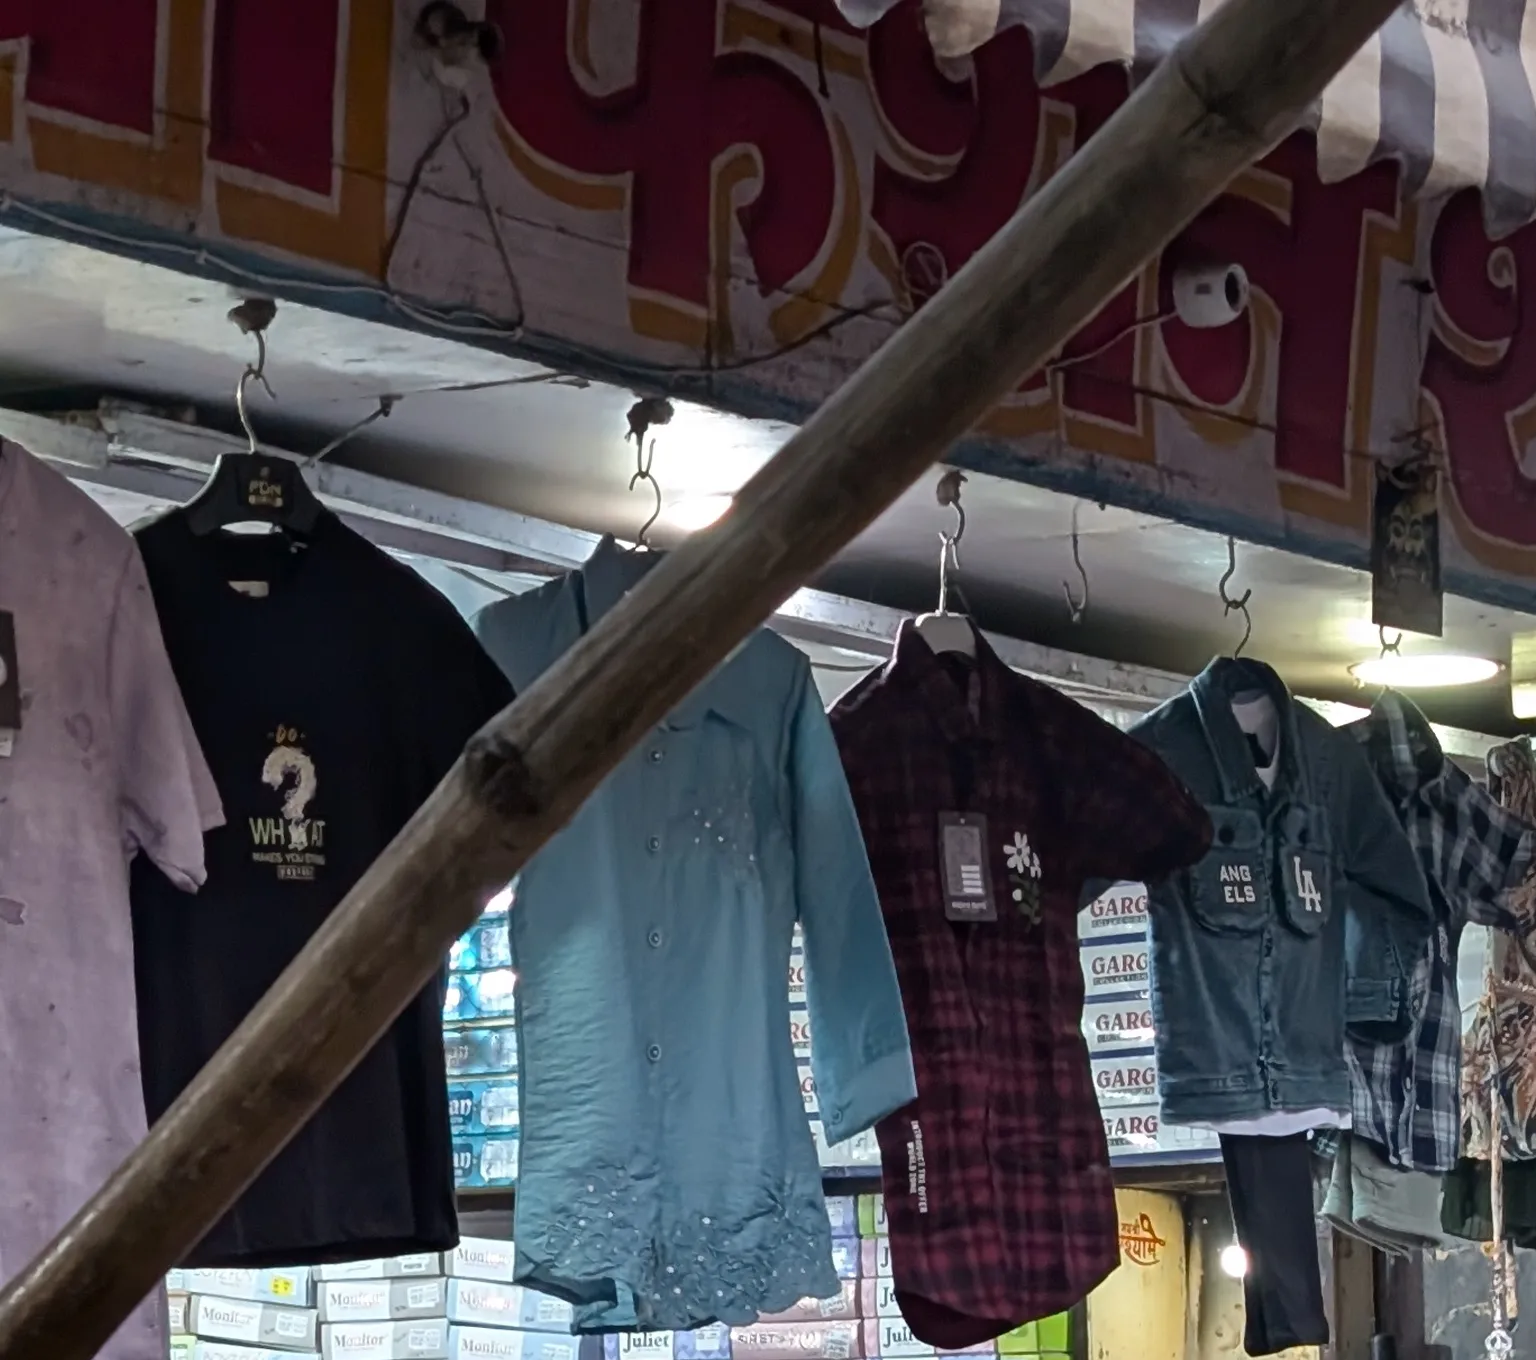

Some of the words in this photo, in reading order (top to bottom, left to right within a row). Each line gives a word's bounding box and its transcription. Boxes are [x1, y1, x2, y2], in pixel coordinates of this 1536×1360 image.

[1220, 865, 1252, 882] ANG
[1293, 856, 1323, 913] LA
[1224, 885, 1256, 903] ELS
[1096, 1066, 1156, 1090] GARG
[623, 1331, 670, 1353] Juliet
